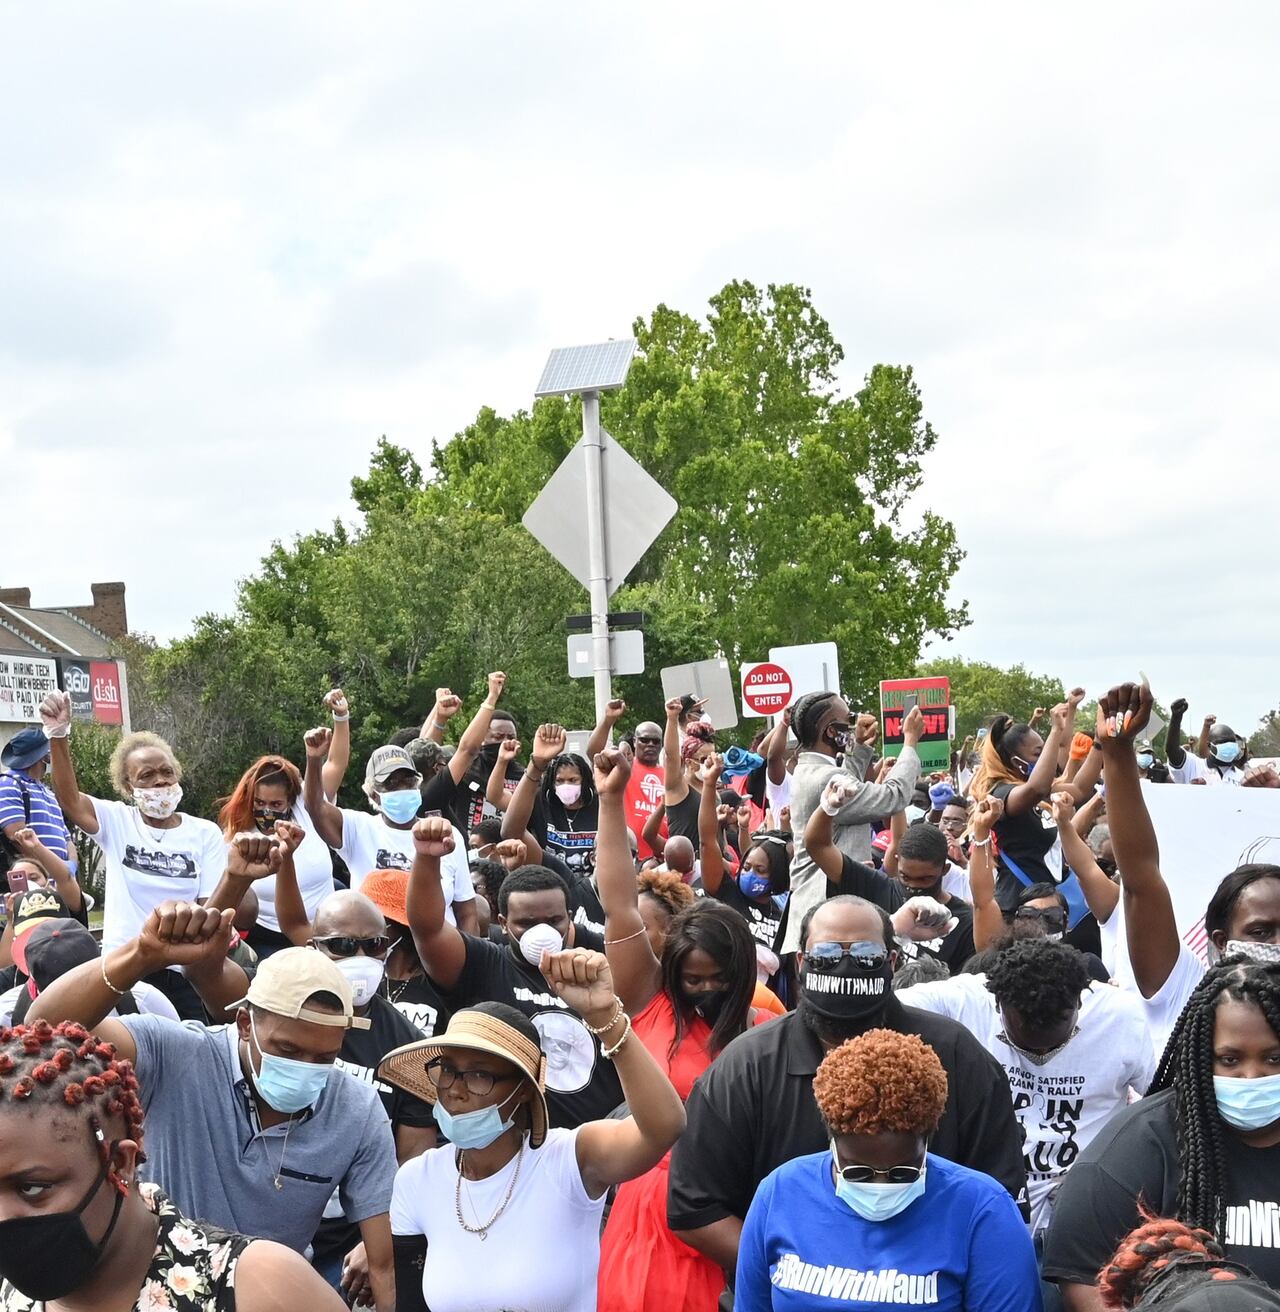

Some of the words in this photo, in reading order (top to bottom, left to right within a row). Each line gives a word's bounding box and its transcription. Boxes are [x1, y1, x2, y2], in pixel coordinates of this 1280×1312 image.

[13, 662, 34, 676] HIRING
[35, 664, 50, 677] TECH
[64, 672, 90, 693] 360
[750, 674, 763, 683] DO
[766, 672, 783, 682] NOT
[93, 677, 118, 702] dish
[16, 690, 32, 704] PAID
[754, 696, 782, 706] ENTER
[23, 705, 35, 718] FOR
[885, 714, 947, 737] NW!
[1038, 1076, 1086, 1085] SATISFIED
[1047, 1086, 1084, 1096] RALLY
[771, 1253, 940, 1305] #iRunWithMaud
